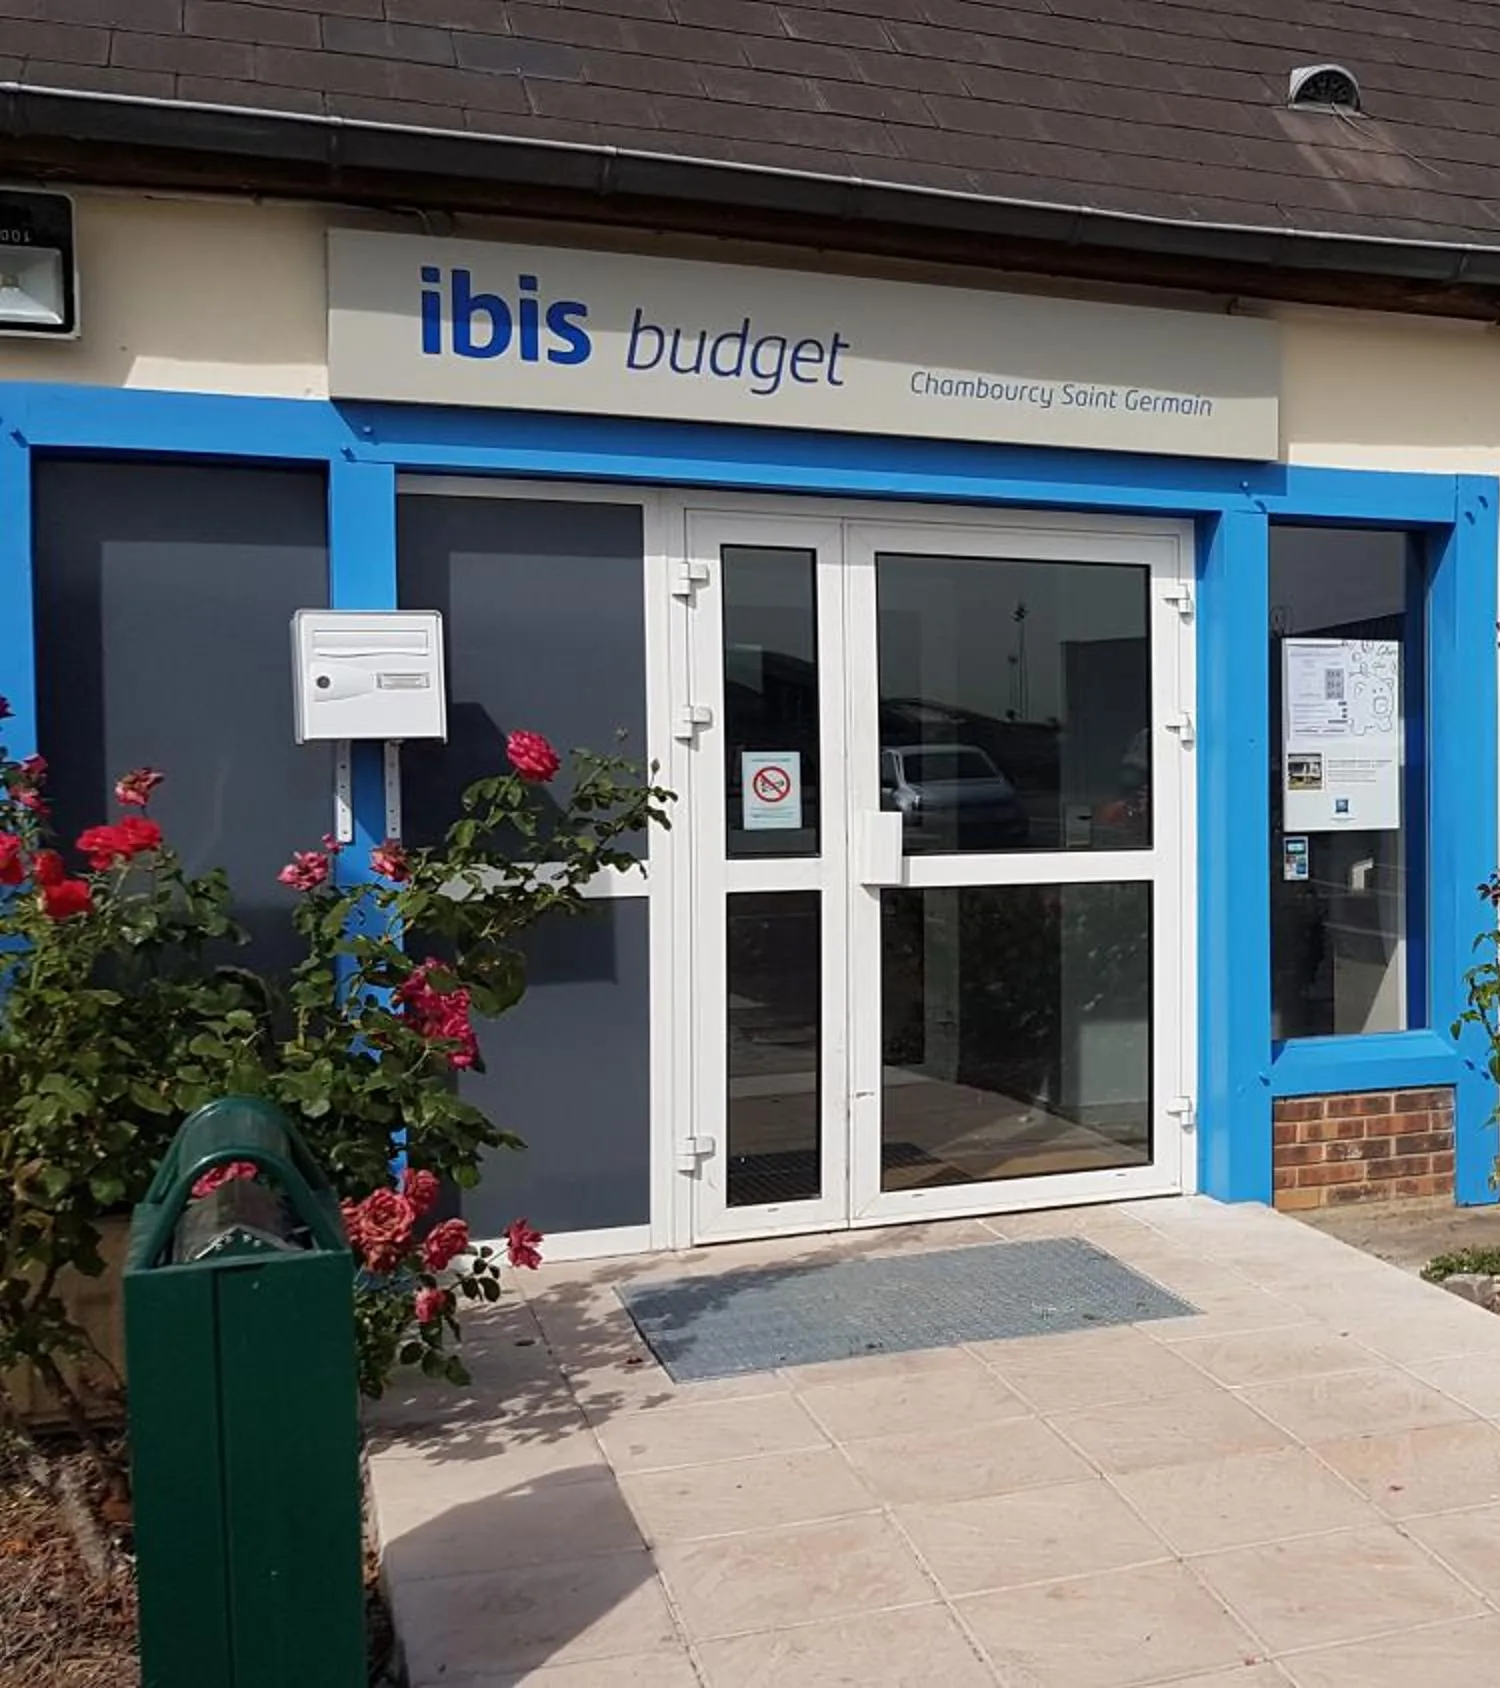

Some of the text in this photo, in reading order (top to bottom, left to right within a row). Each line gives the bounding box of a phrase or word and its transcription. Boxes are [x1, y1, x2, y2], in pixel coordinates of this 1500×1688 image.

[419, 266, 850, 396] ibis budget
[909, 371, 1213, 417] Chambourcy Saint Germain
